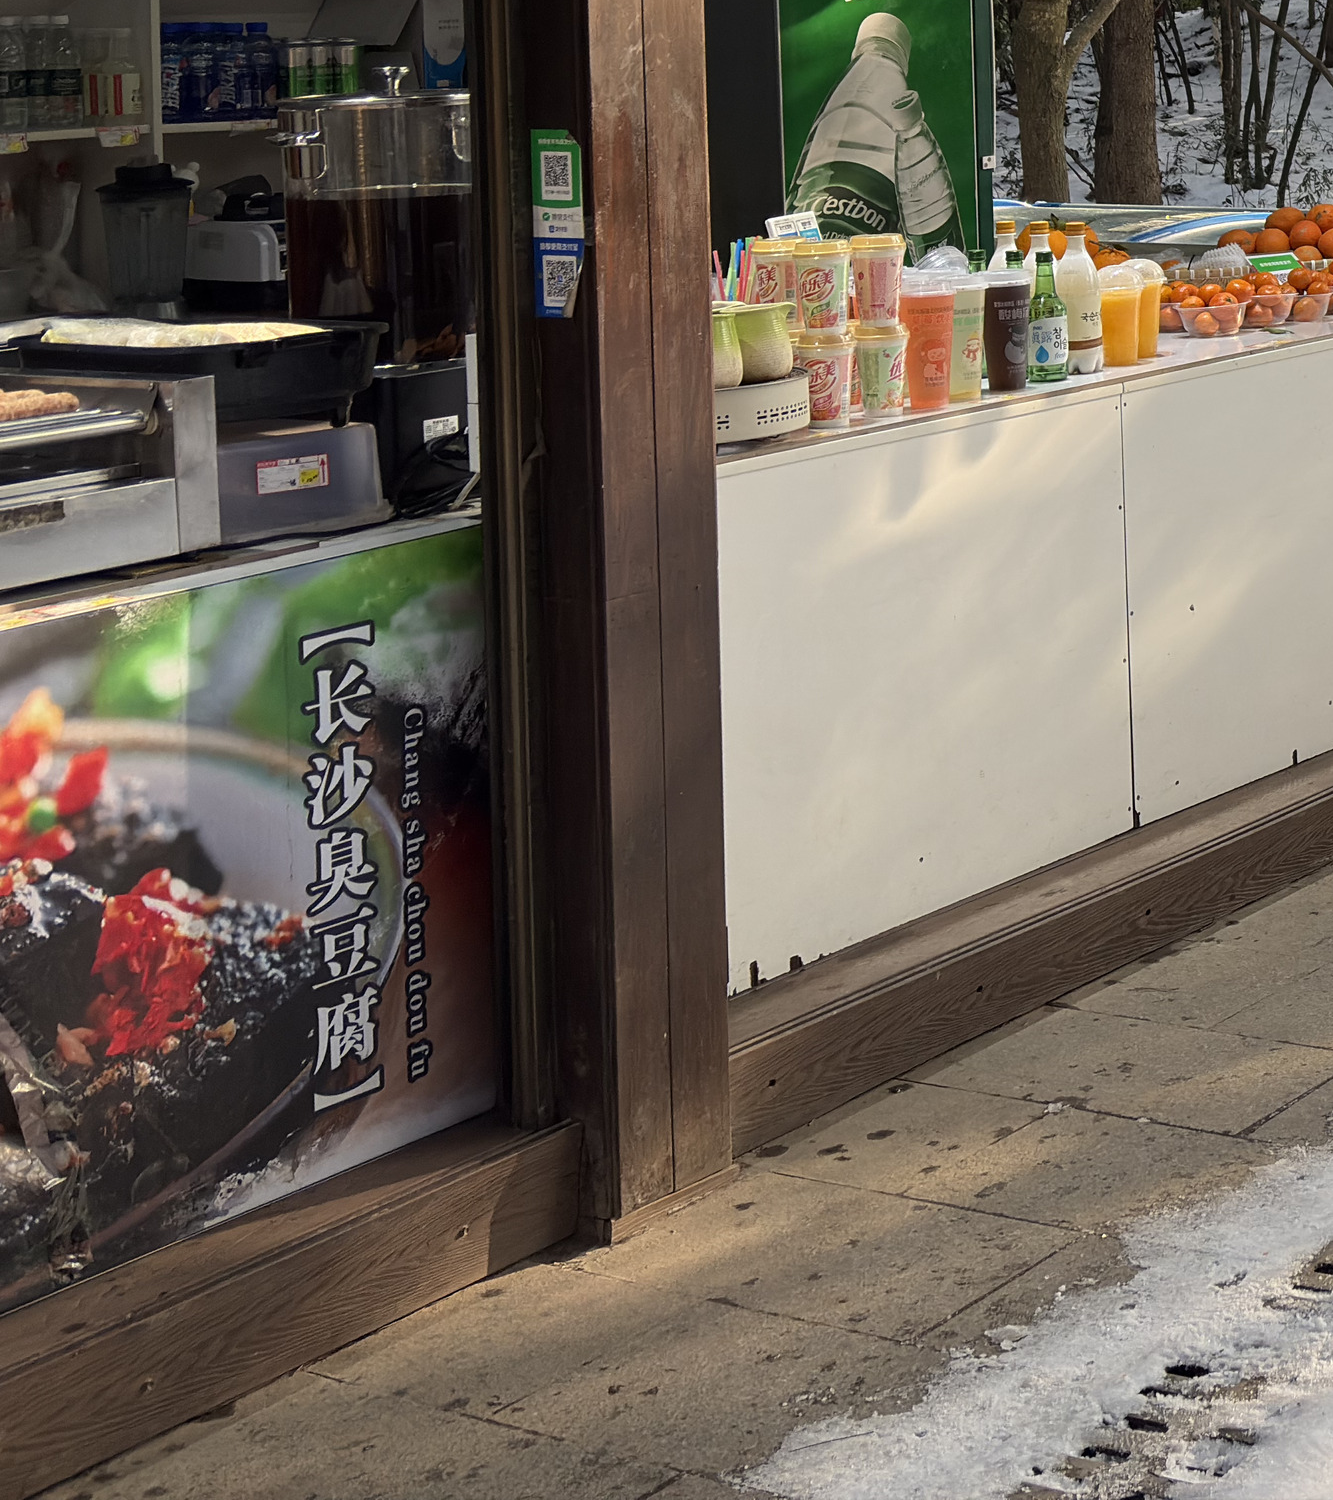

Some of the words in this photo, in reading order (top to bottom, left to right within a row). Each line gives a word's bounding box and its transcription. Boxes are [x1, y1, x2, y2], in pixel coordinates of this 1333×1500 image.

[403, 707, 423, 808] Chang
[405, 819, 426, 873] sha
[406, 879, 429, 964] chou
[406, 970, 429, 1036] dou
[407, 1040, 429, 1080] fu
